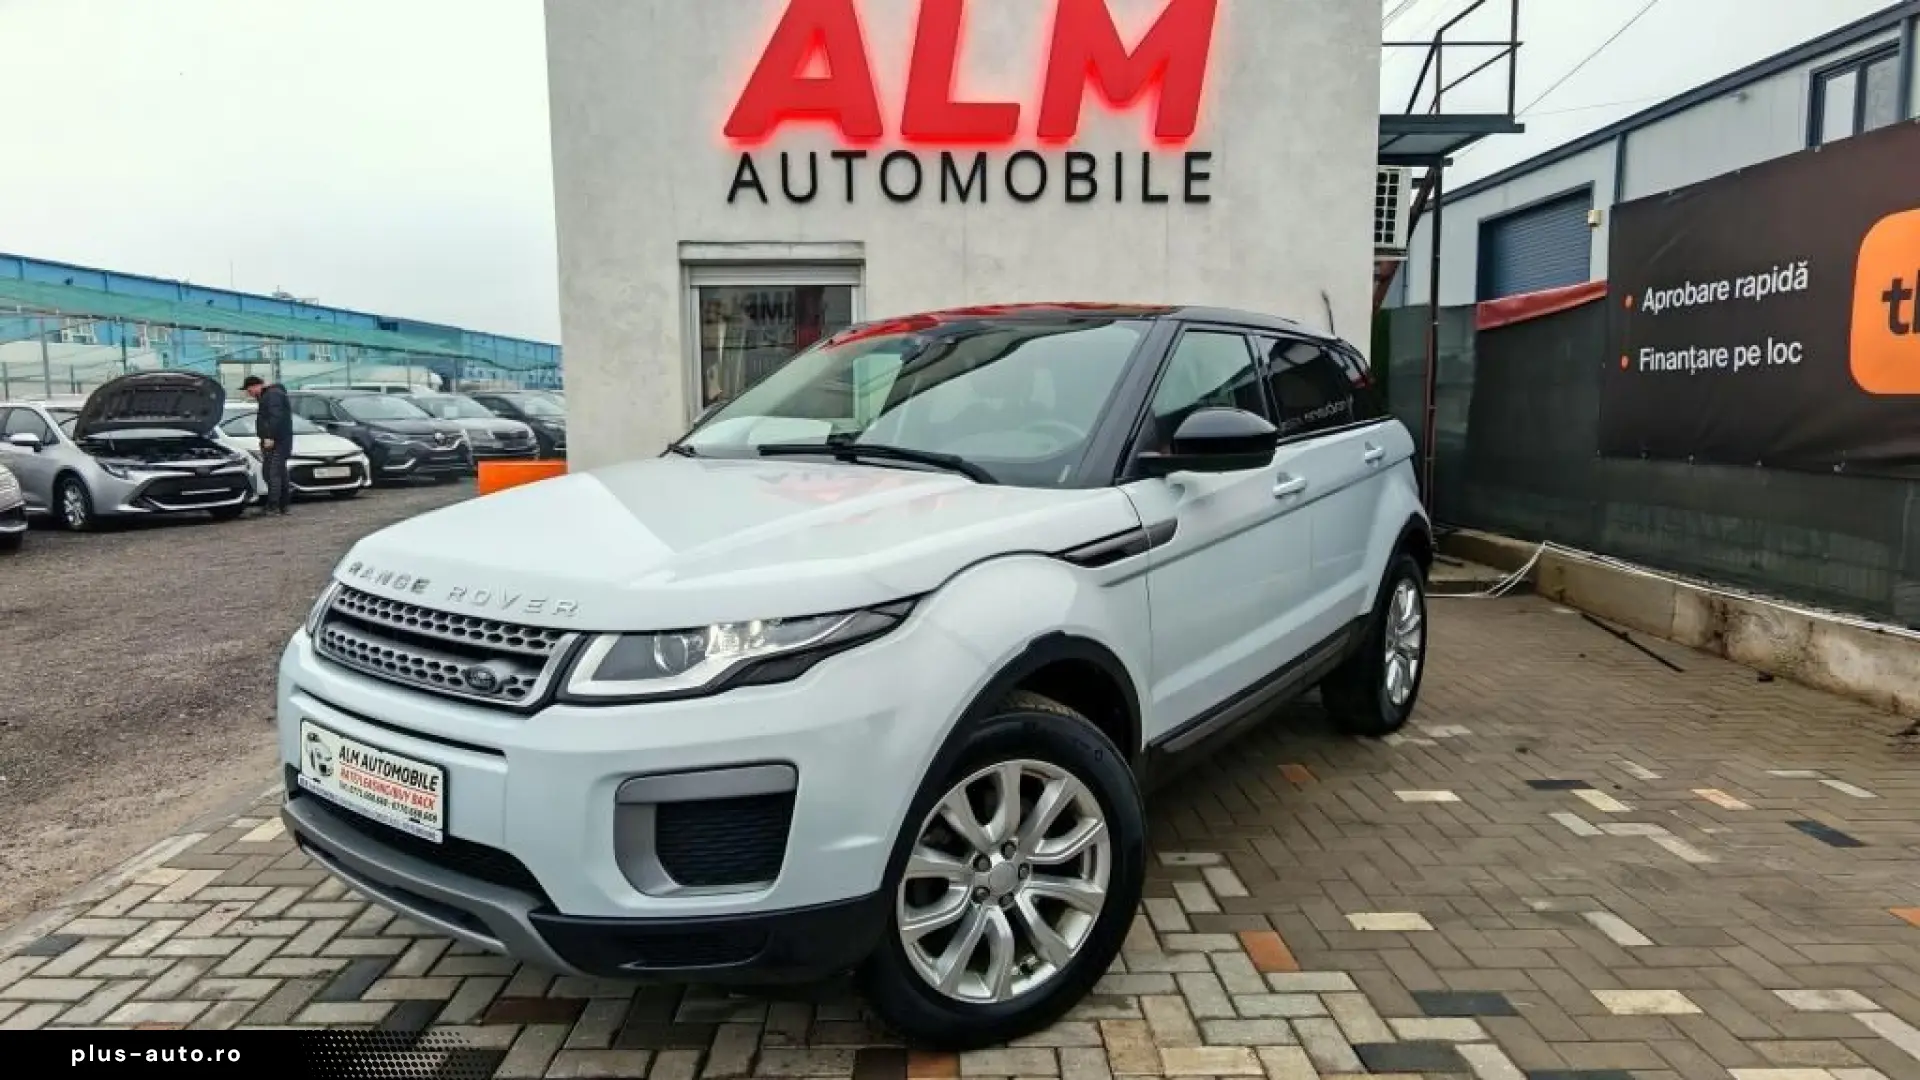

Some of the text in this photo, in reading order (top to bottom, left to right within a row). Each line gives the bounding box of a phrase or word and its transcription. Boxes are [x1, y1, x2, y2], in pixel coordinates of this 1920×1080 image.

[723, 0, 1217, 138] ALM
[727, 150, 1212, 204] AUTOMOBILE
[1642, 260, 1809, 315] Aprobare rapidă
[1640, 337, 1803, 375] Finanțare pe loc
[349, 561, 579, 617] RANGE ROVER
[362, 753, 439, 791] AUTOMOBILE
[411, 791, 436, 810] BACK
